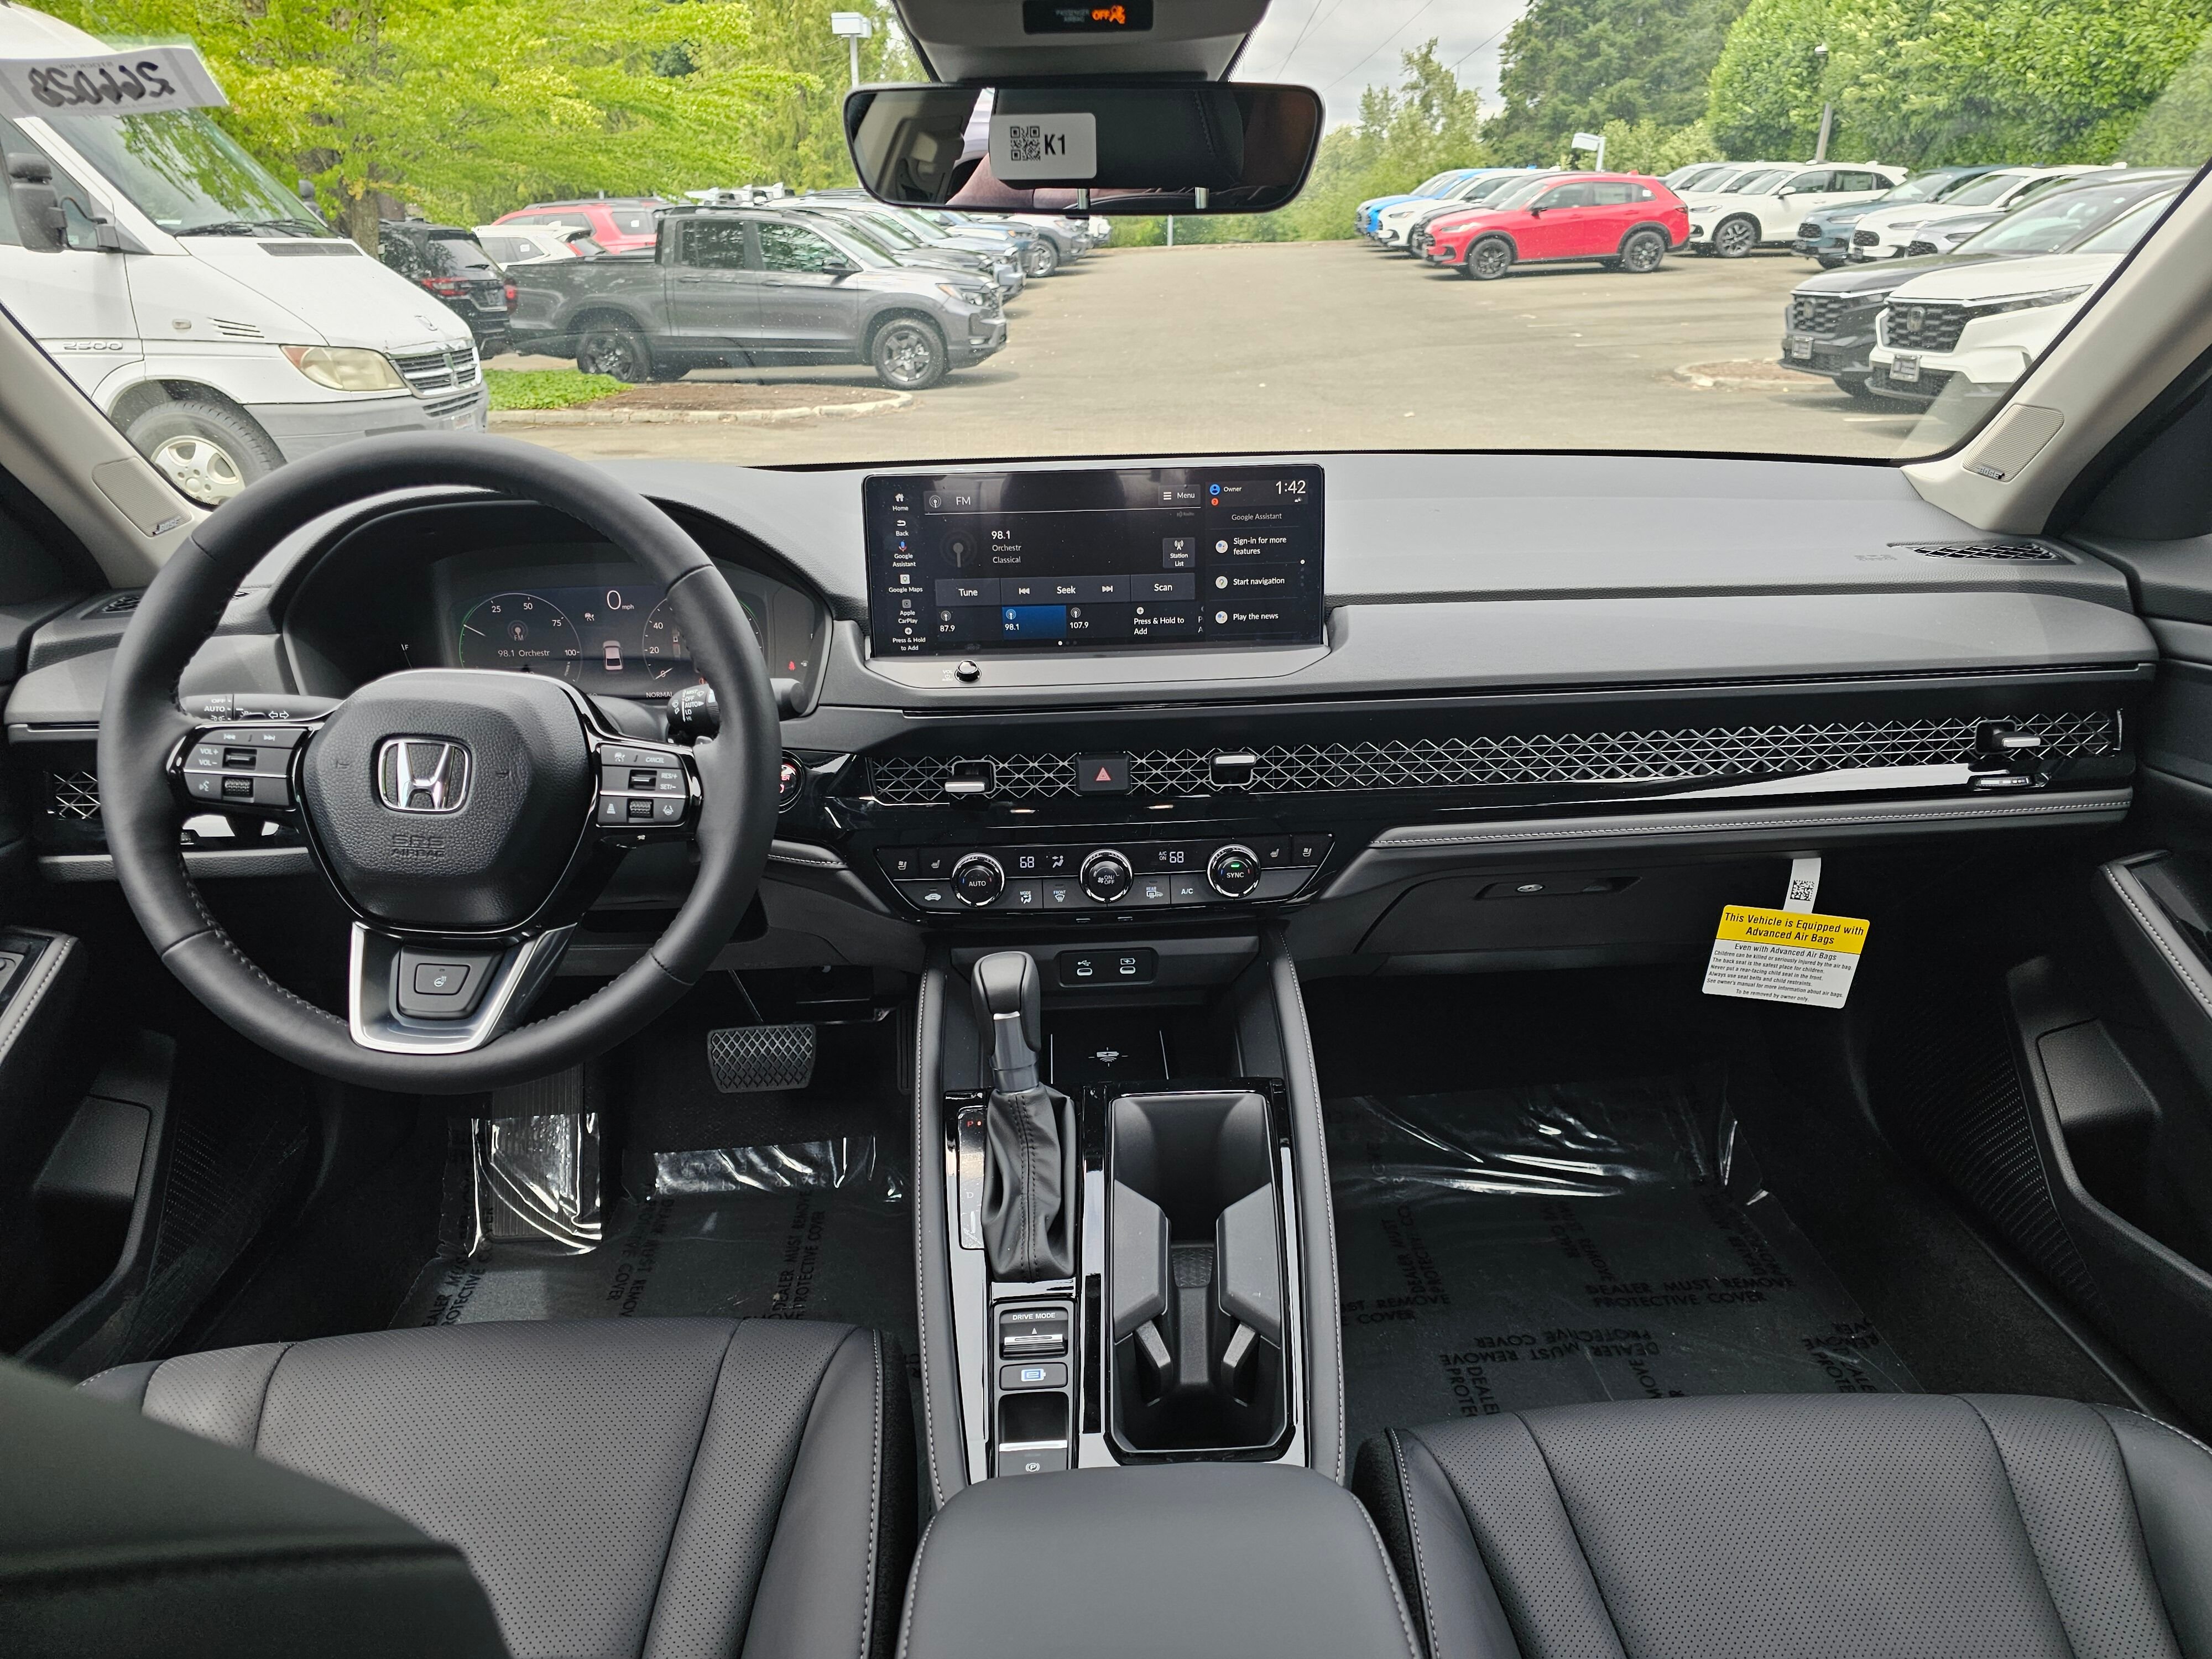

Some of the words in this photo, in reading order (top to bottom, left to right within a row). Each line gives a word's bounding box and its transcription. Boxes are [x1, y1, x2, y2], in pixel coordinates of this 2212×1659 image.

[1092, 9, 1110, 21] OFF
[1044, 134, 1066, 155] K1
[63, 341, 123, 350] 2500
[1276, 480, 1306, 494] 1:42
[956, 497, 971, 505] FM
[992, 530, 1010, 539] 98.1
[1233, 537, 1256, 546] Sign-in
[1154, 583, 1172, 591] Scan
[1250, 577, 1285, 586] navigation
[958, 588, 978, 597] Tune
[1057, 586, 1076, 594] Seek
[607, 590, 622, 610] 0
[1070, 621, 1089, 629] 107.9
[519, 649, 550, 657] Orchestr
[1020, 856, 1035, 868] 68
[1170, 851, 1184, 863] 68
[1725, 912, 1744, 922] This
[1748, 915, 1782, 926] Vehicle
[1785, 919, 1793, 927] is
[1796, 920, 1841, 932] Equipped
[1844, 926, 1864, 936] with
[1746, 927, 1792, 939] Advanced
[1794, 932, 1809, 941] Air
[1811, 934, 1835, 945] Bags
[1770, 947, 1806, 956] Advanced
[1819, 953, 1837, 961] Bags
[785, 1234, 802, 1264] MUST
[1585, 1282, 1652, 1295] DEALER
[1663, 1279, 1713, 1292] MUST
[1376, 1294, 1452, 1309] REMOVE
[1593, 1294, 1700, 1307] PROTECTIVE
[1707, 1291, 1767, 1304] COVER
[1357, 1310, 1416, 1324] COVER
[1473, 1334, 1536, 1348] COVER
[1546, 1327, 1652, 1343] PROTECTIVE
[1531, 1342, 1579, 1360] MUST
[1593, 1342, 1658, 1357] DEALER
[1439, 1349, 1519, 1366] REMOVE
